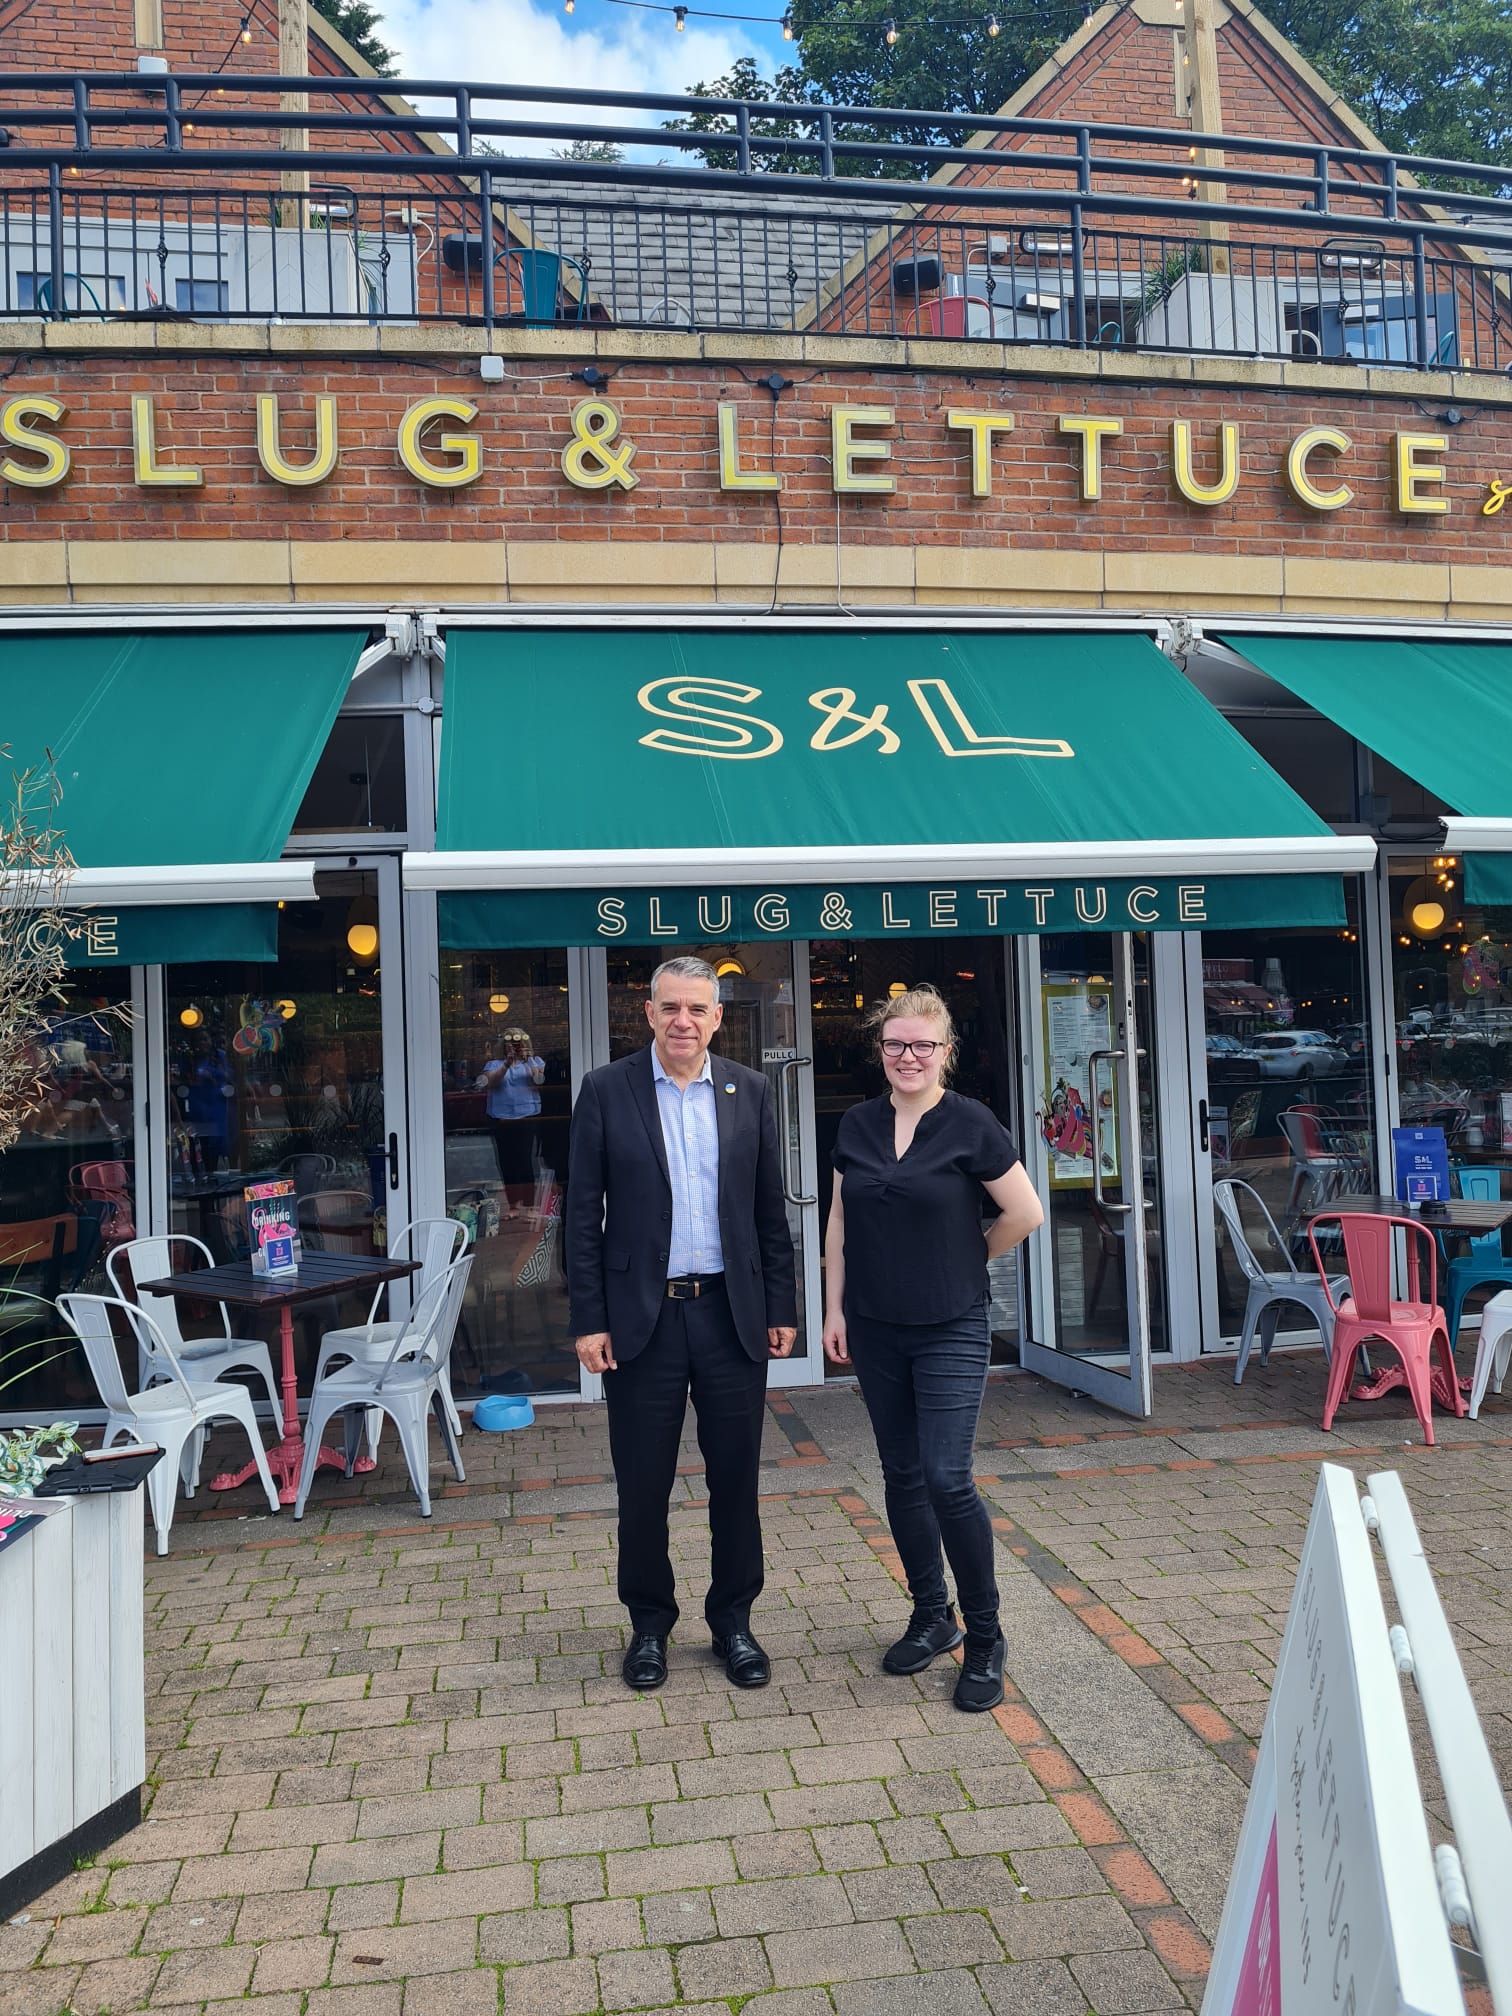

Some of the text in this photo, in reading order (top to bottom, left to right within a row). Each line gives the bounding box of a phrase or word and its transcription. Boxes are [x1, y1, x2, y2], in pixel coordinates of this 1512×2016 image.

[0, 394, 1453, 515] SLUG & LETTUCE
[597, 884, 1208, 937] SLUG & LETTUCE
[764, 1051, 787, 1060] PULL
[254, 1211, 290, 1227] DRINKING
[1303, 1567, 1322, 1689] SLUG
